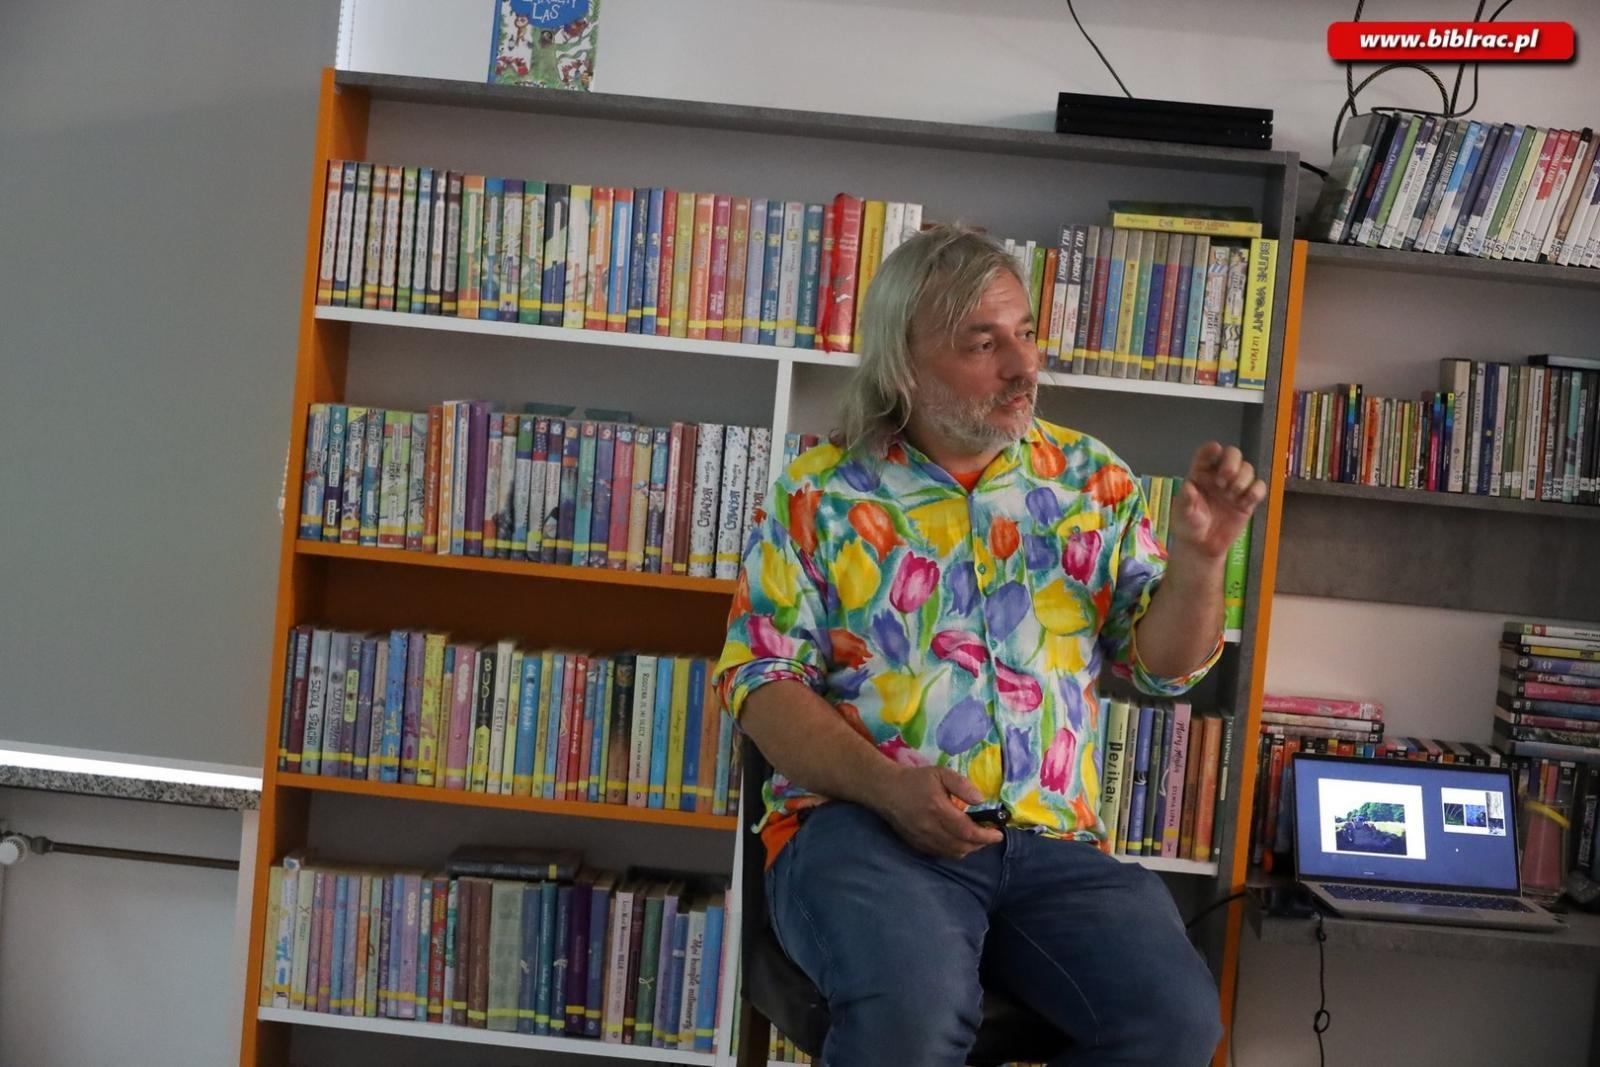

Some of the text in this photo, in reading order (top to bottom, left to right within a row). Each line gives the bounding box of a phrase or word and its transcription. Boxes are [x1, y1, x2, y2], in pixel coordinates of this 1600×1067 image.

[532, 2, 560, 23] LAS
[1495, 244, 1505, 253] 52
[1251, 286, 1266, 333] WOJNY
[1251, 336, 1260, 347] Liz
[523, 420, 532, 432] 4
[637, 432, 648, 443] 12
[305, 712, 319, 745] STRACHU
